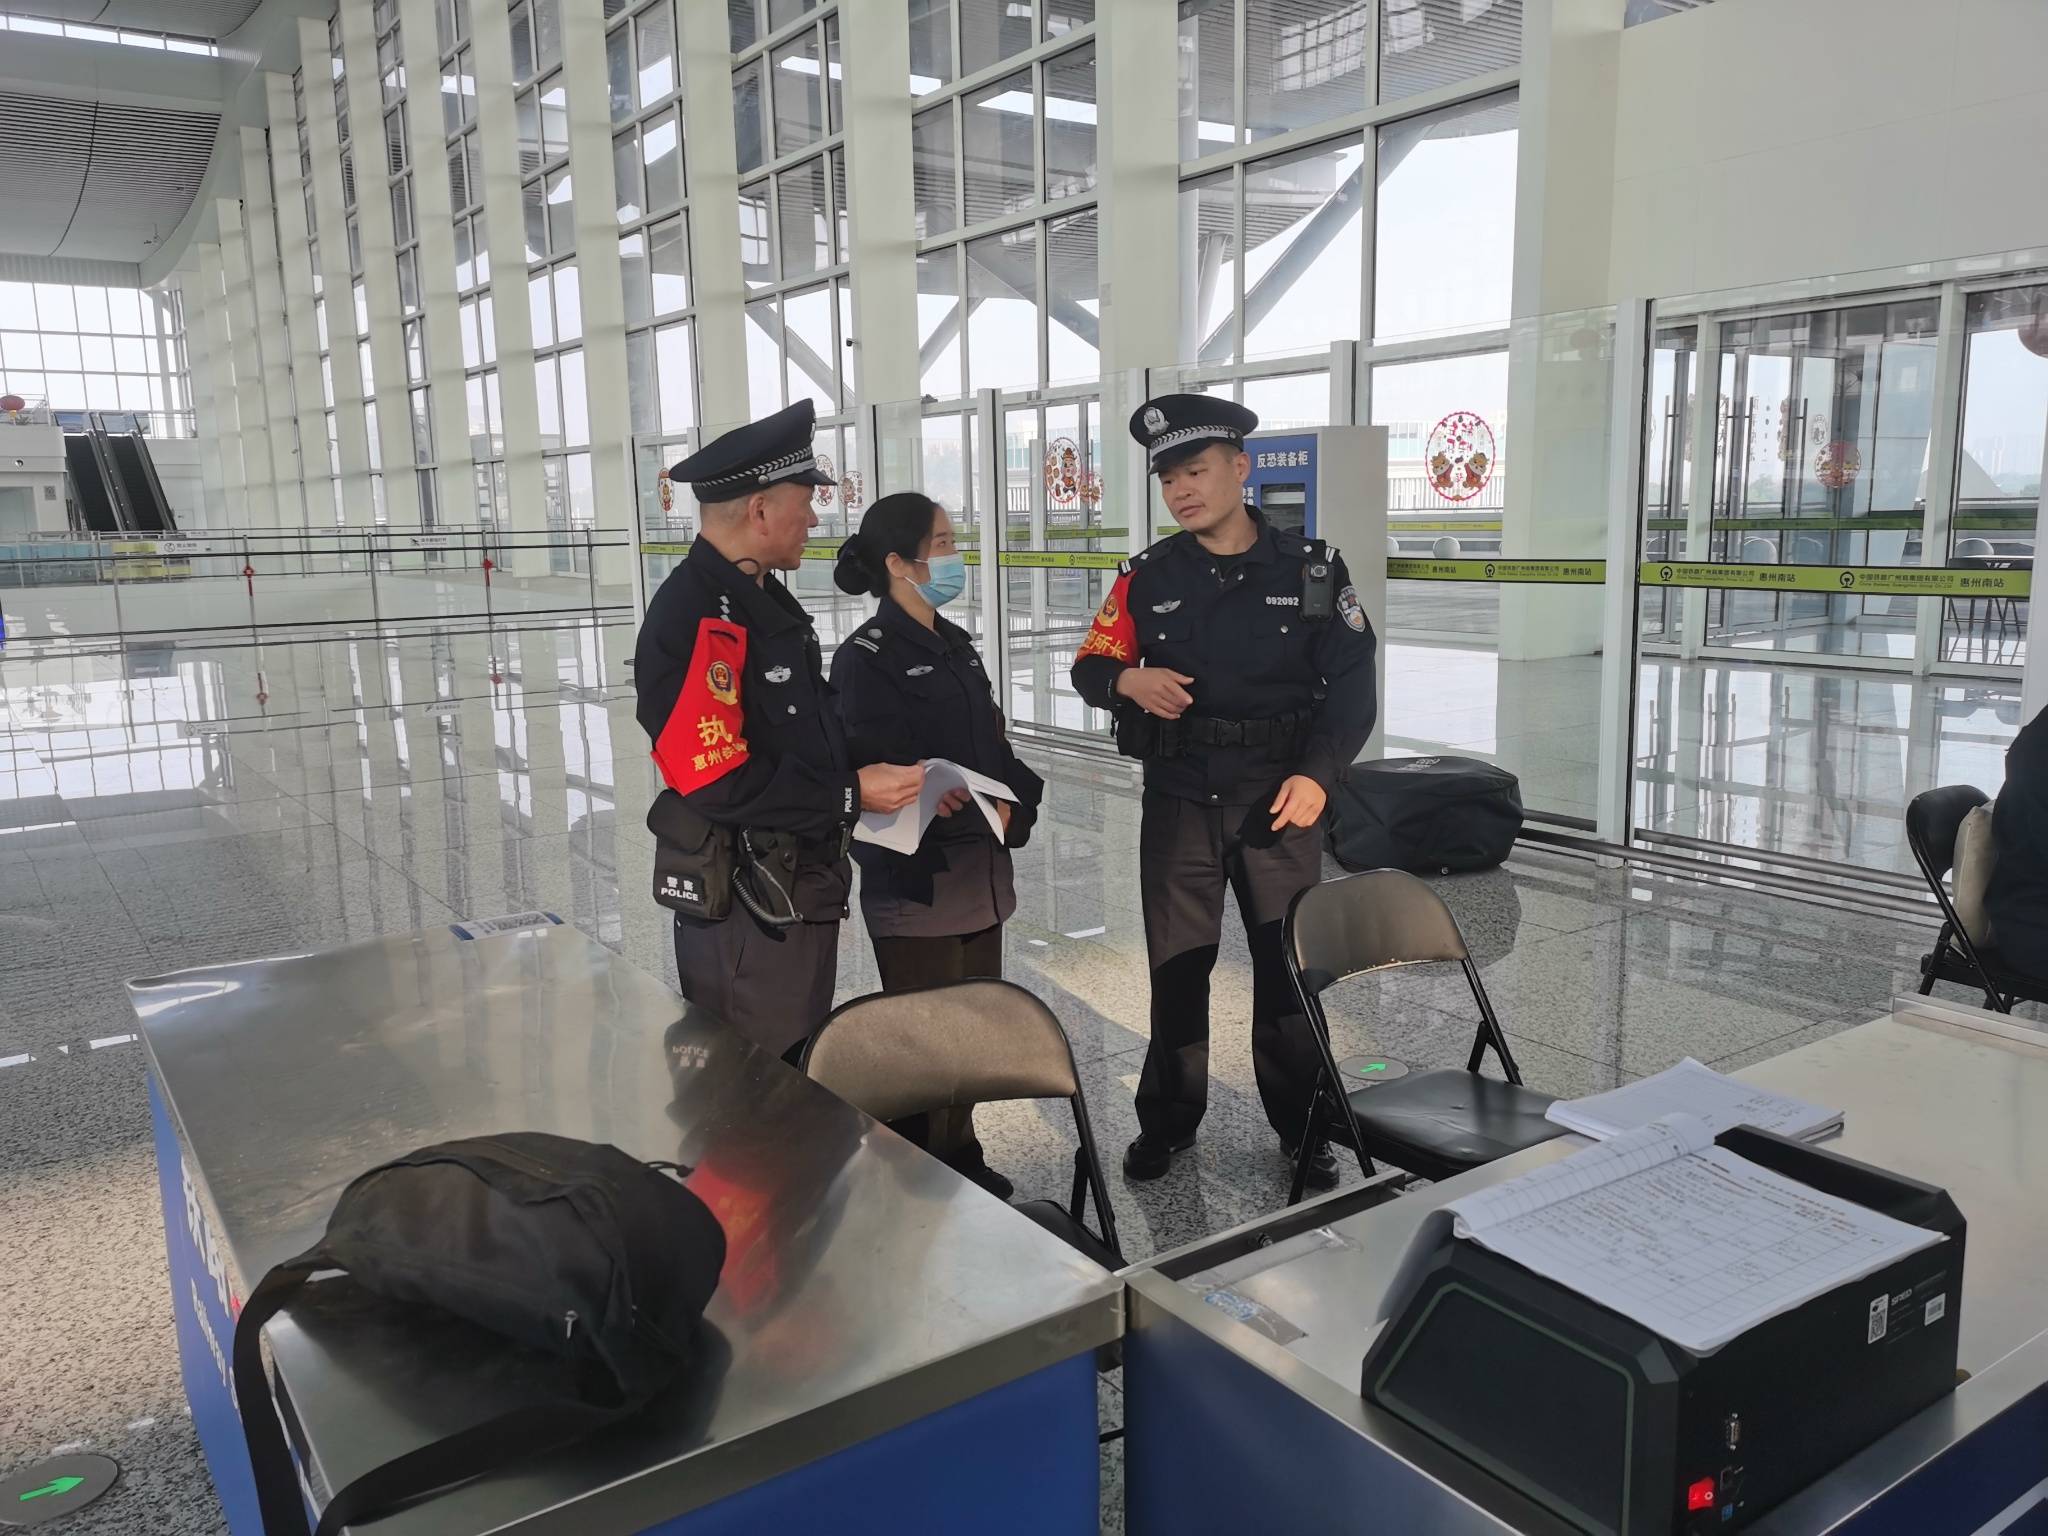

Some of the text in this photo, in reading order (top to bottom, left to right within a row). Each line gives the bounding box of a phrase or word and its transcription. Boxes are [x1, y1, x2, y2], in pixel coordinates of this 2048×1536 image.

[1256, 450, 1309, 468] 反恐装备柜
[1759, 573, 1796, 583] 惠州南站
[1959, 577, 2005, 588] 惠州南站
[697, 714, 733, 747] 执
[844, 787, 853, 813] POLICE
[660, 887, 699, 902] POLICE
[190, 1276, 227, 1388] Railway
